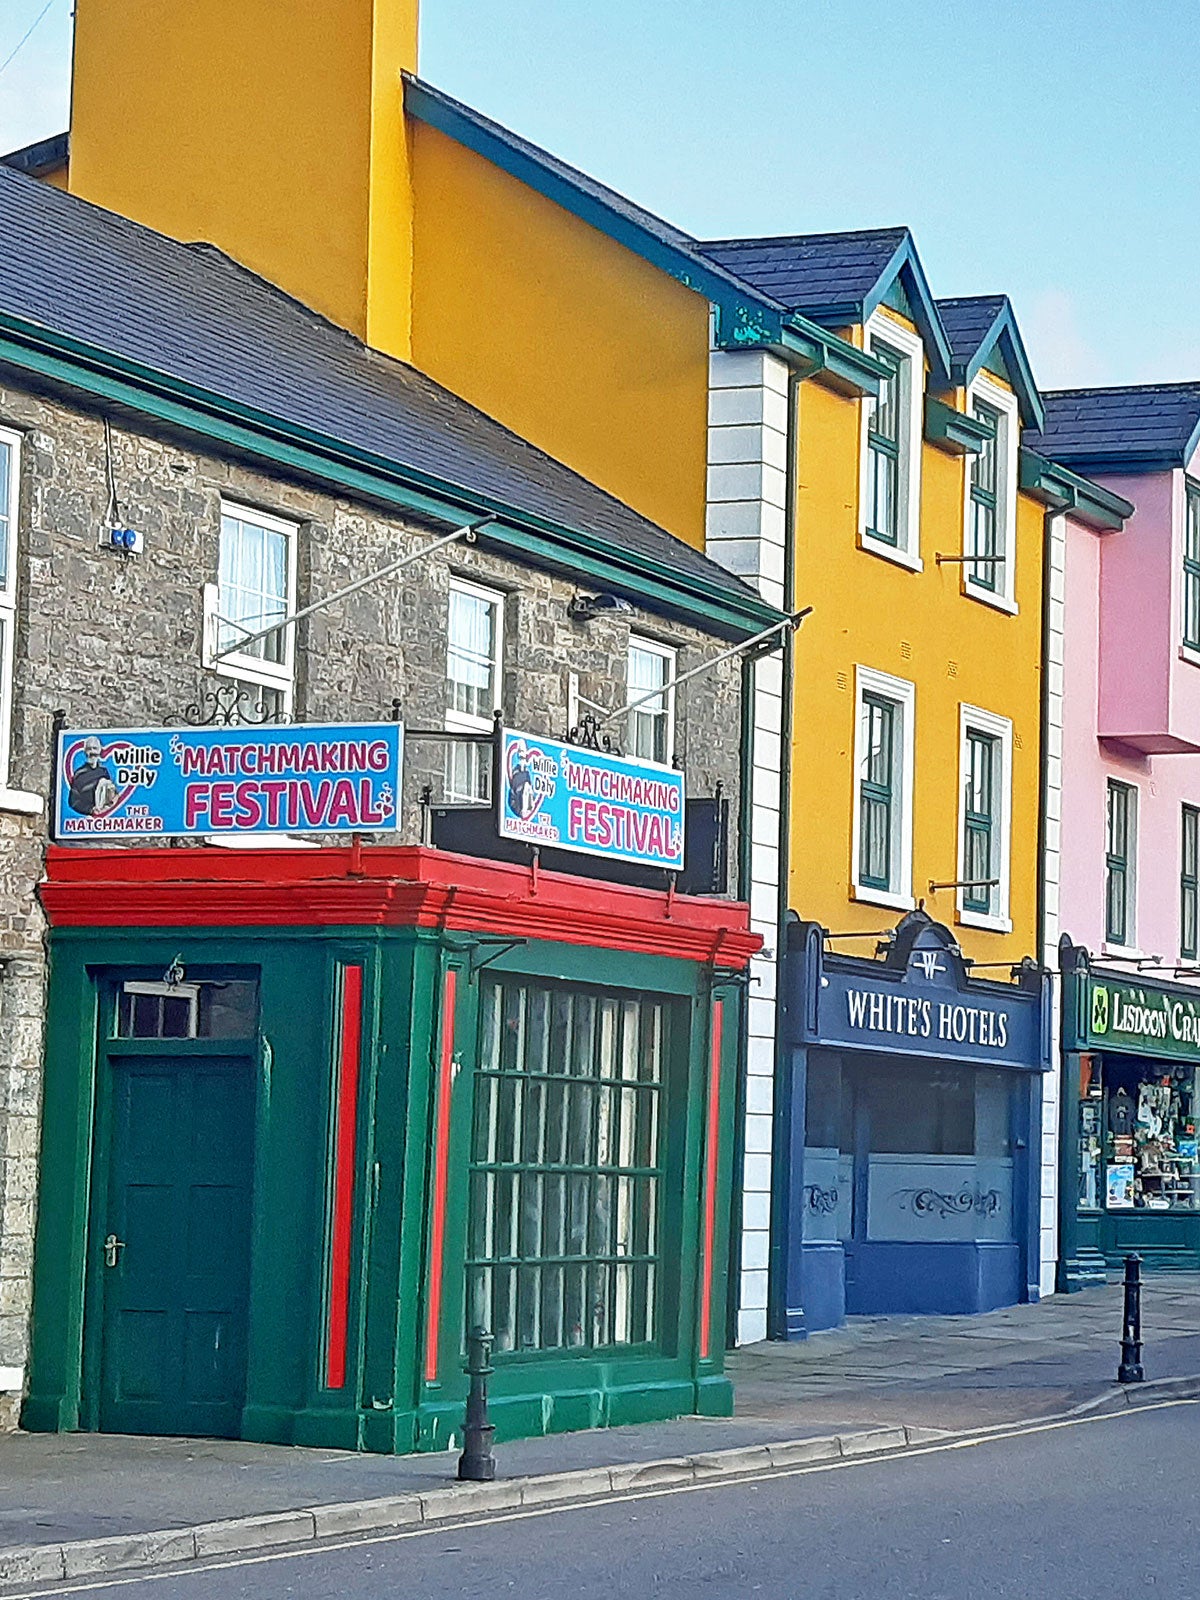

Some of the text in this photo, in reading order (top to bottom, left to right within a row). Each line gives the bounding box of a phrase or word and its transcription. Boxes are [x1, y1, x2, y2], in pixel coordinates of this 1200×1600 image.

[113, 747, 161, 764] Willie
[182, 741, 388, 775] MATCHMAKING
[532, 757, 557, 776] Willie
[118, 768, 156, 786] Daly
[534, 776, 554, 796] Daly
[568, 764, 679, 812] MATCHMAKING
[126, 806, 148, 815] THE
[185, 779, 383, 827] FESTIVAL
[65, 817, 162, 831] MATCHMAKER
[505, 819, 558, 840] MATCHMAKER
[569, 798, 677, 857] FESTIVAL
[847, 989, 1008, 1048] WHITE'S HOTELS
